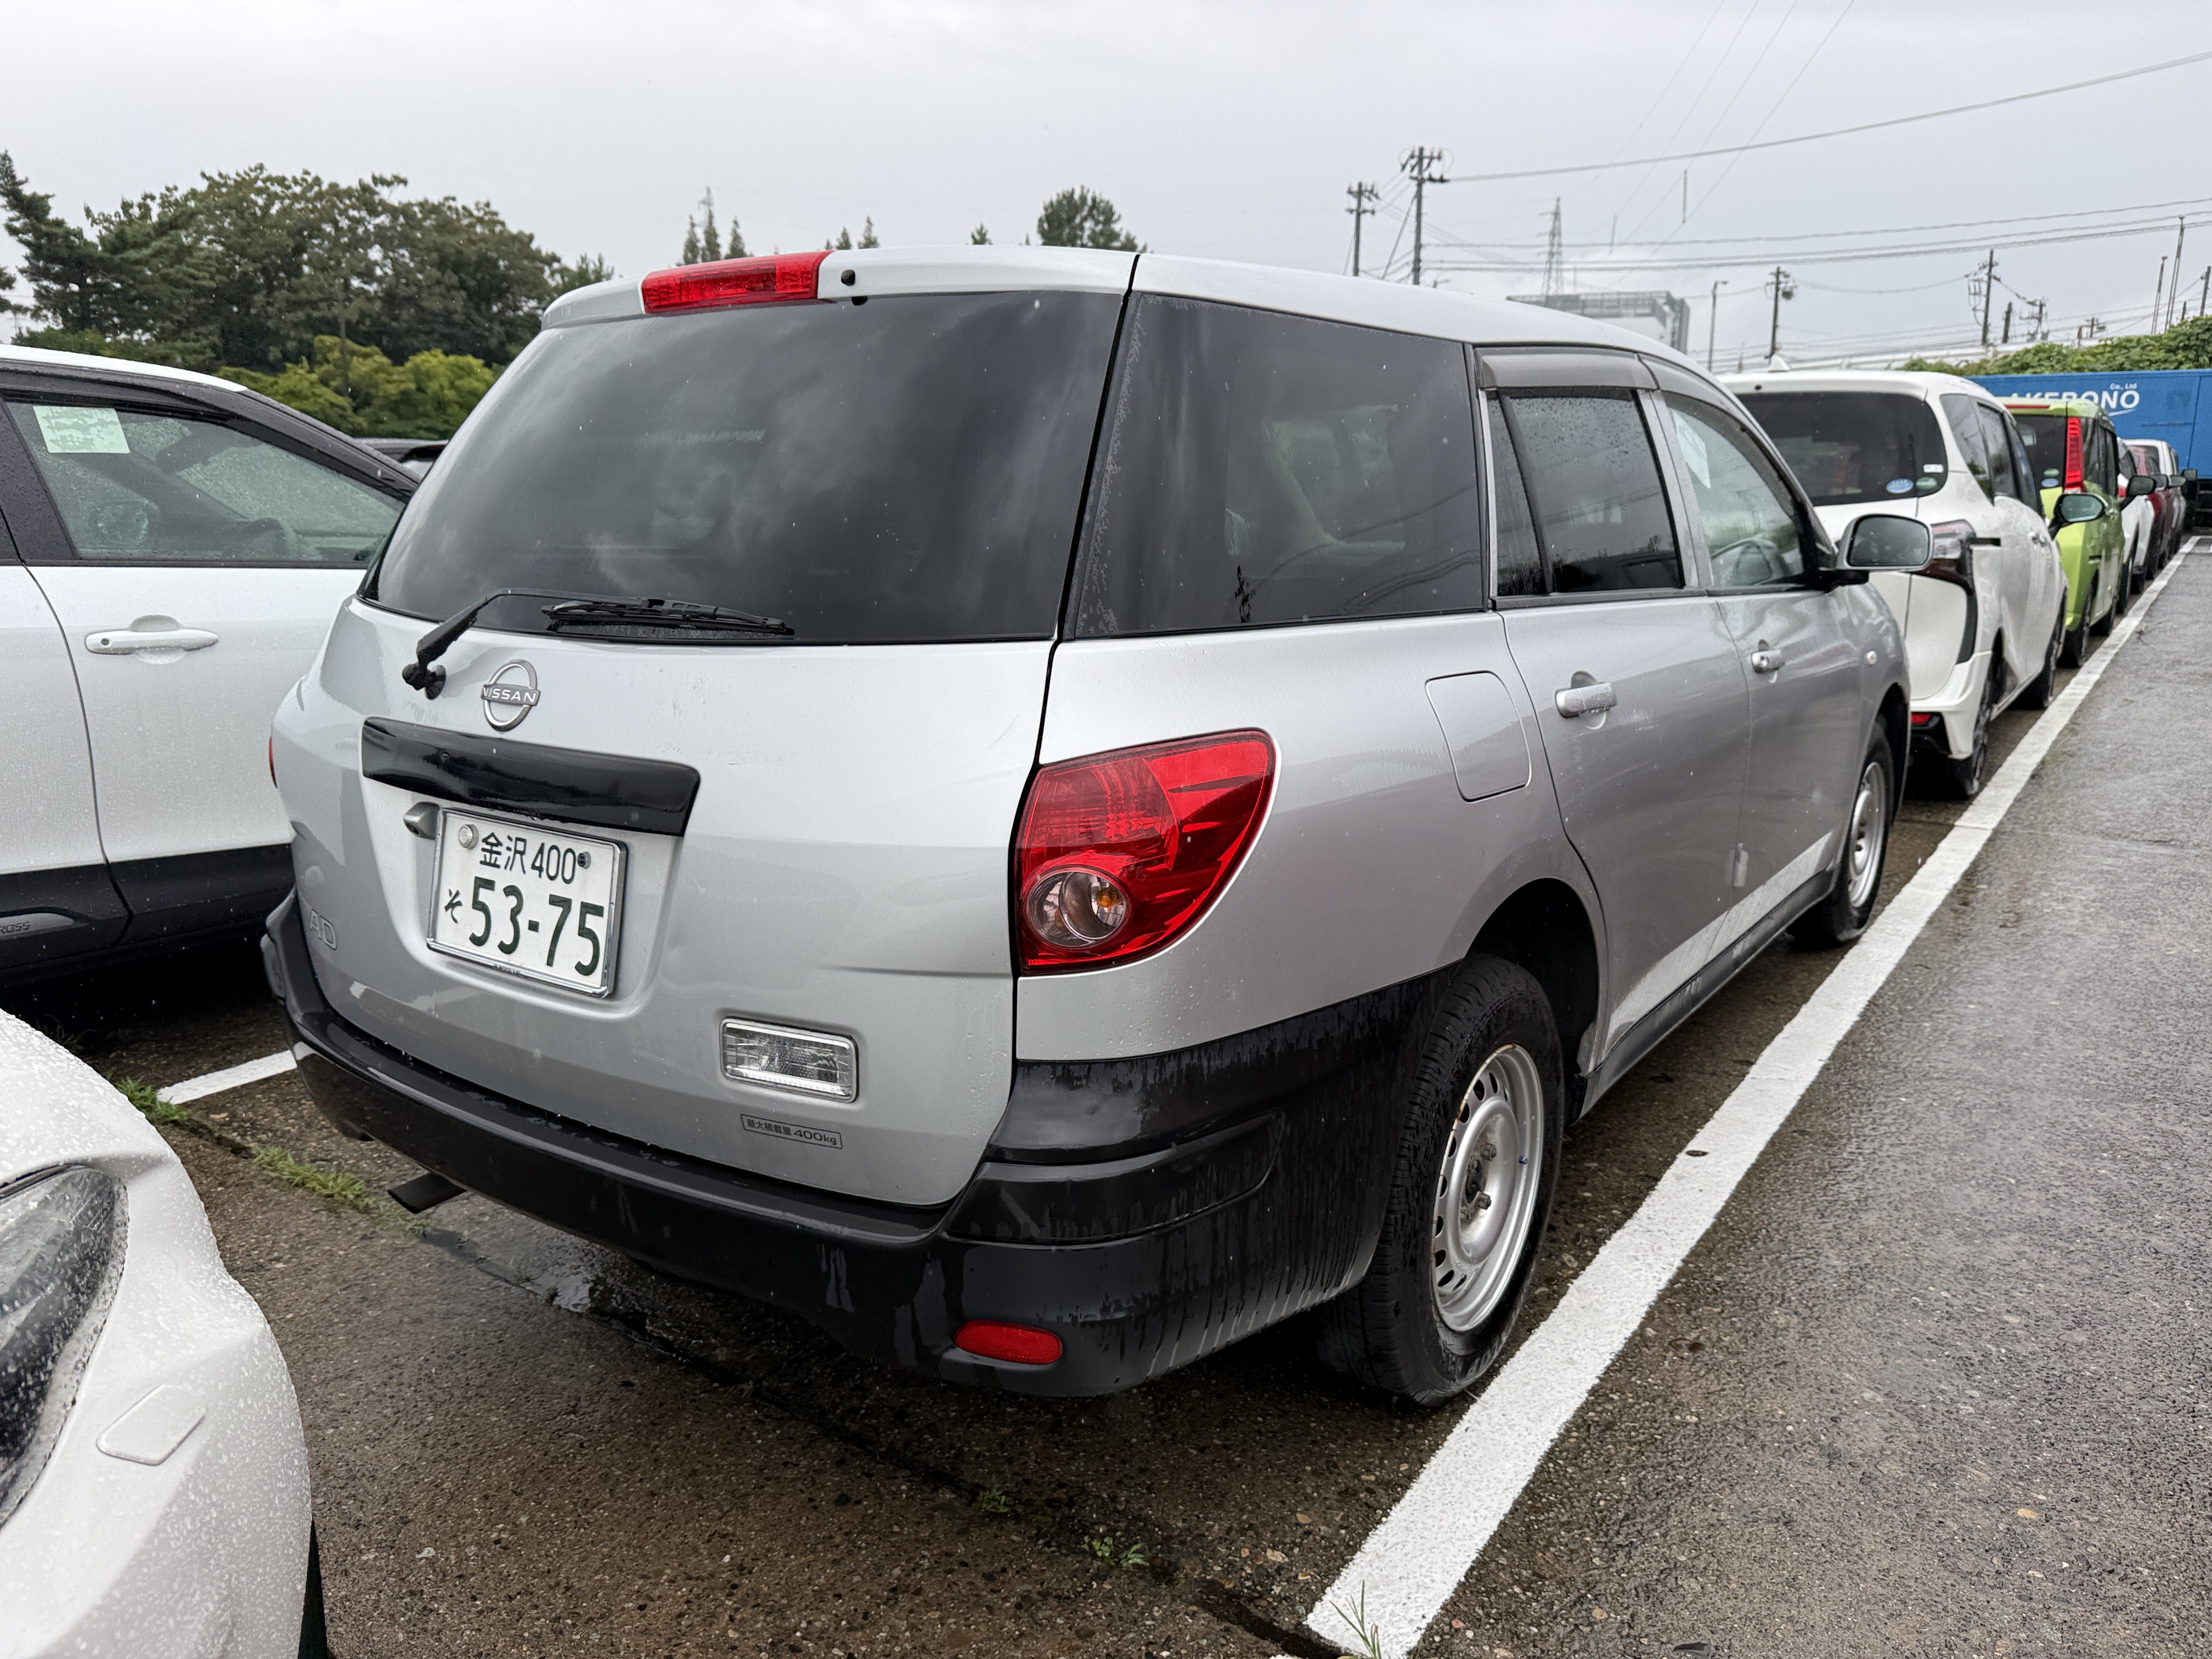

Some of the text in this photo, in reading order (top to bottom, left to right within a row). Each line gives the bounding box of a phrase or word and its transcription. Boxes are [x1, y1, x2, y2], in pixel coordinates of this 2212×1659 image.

[483, 687, 537, 703] NISSAN
[310, 909, 337, 951] AD
[444, 876, 604, 976] そ 53-75
